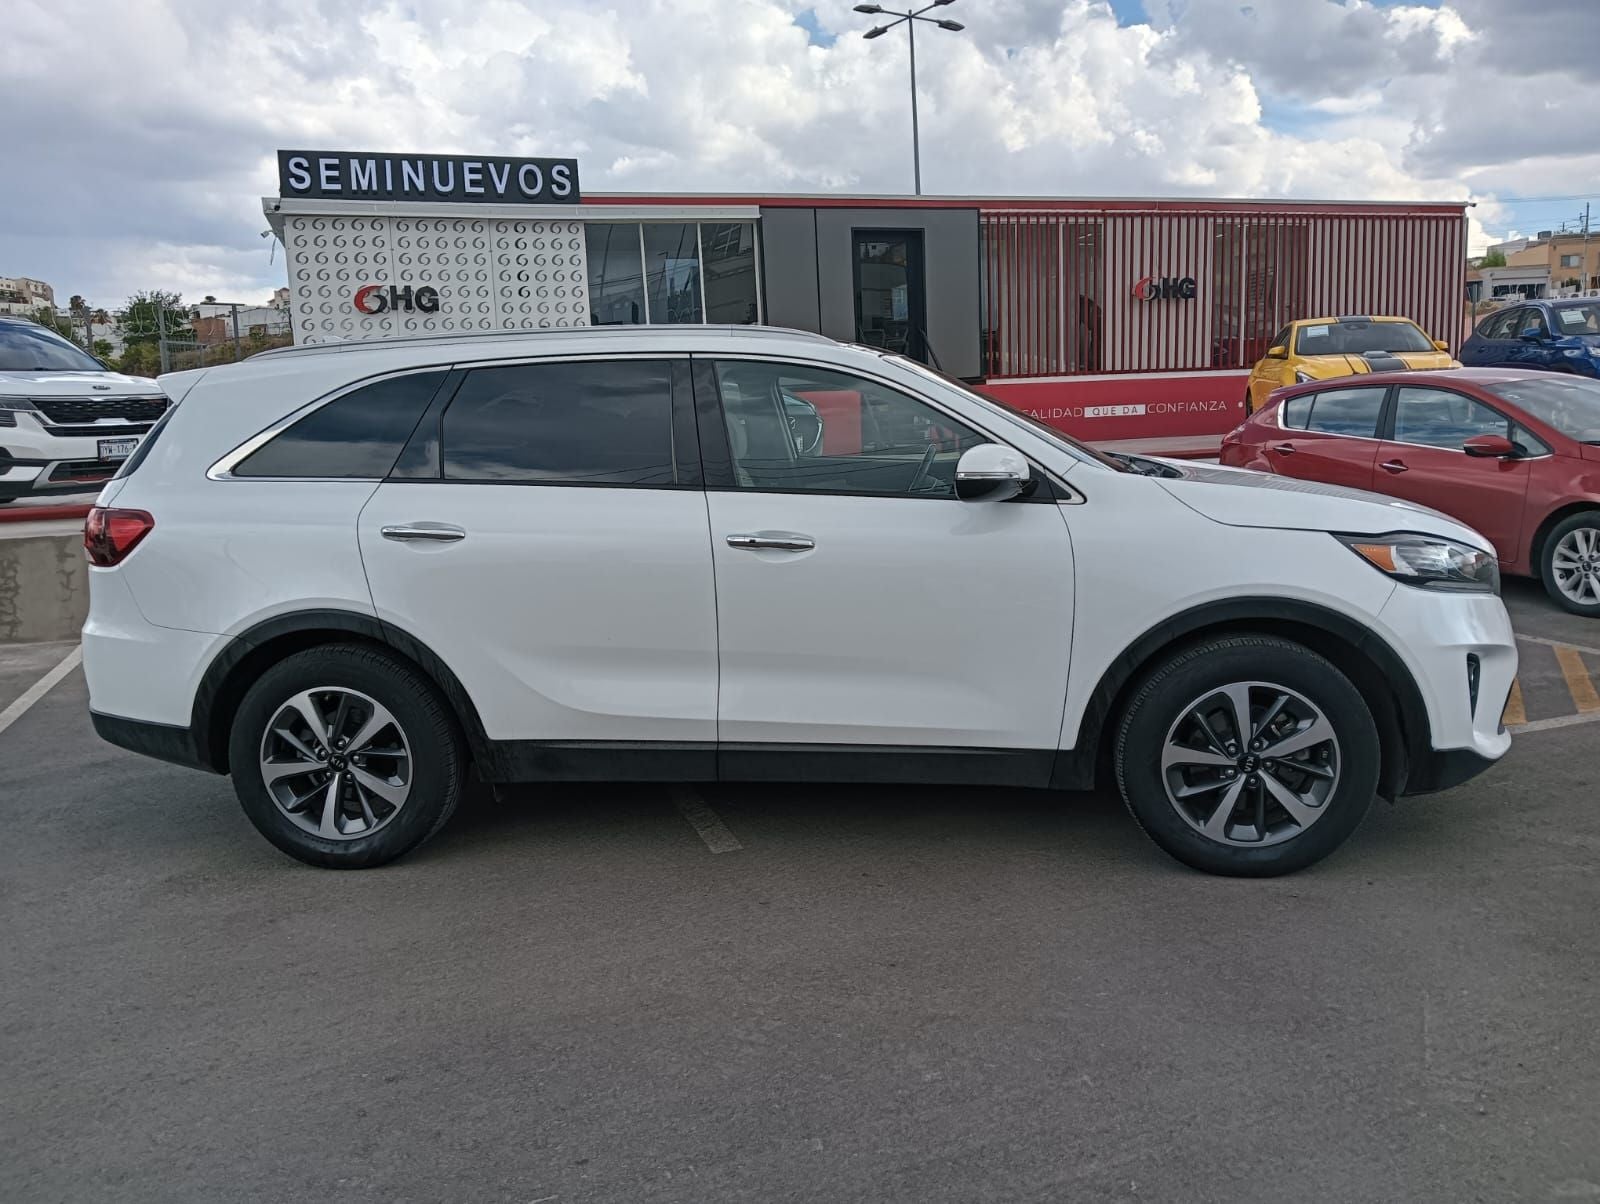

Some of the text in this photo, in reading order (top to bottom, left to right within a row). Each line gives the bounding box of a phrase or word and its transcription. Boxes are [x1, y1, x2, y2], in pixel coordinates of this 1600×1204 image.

[288, 157, 572, 196] SEMINUEVOS
[1092, 407, 1117, 416] QUE
[1122, 406, 1138, 415] DA
[1147, 401, 1227, 413] CONFIANZA
